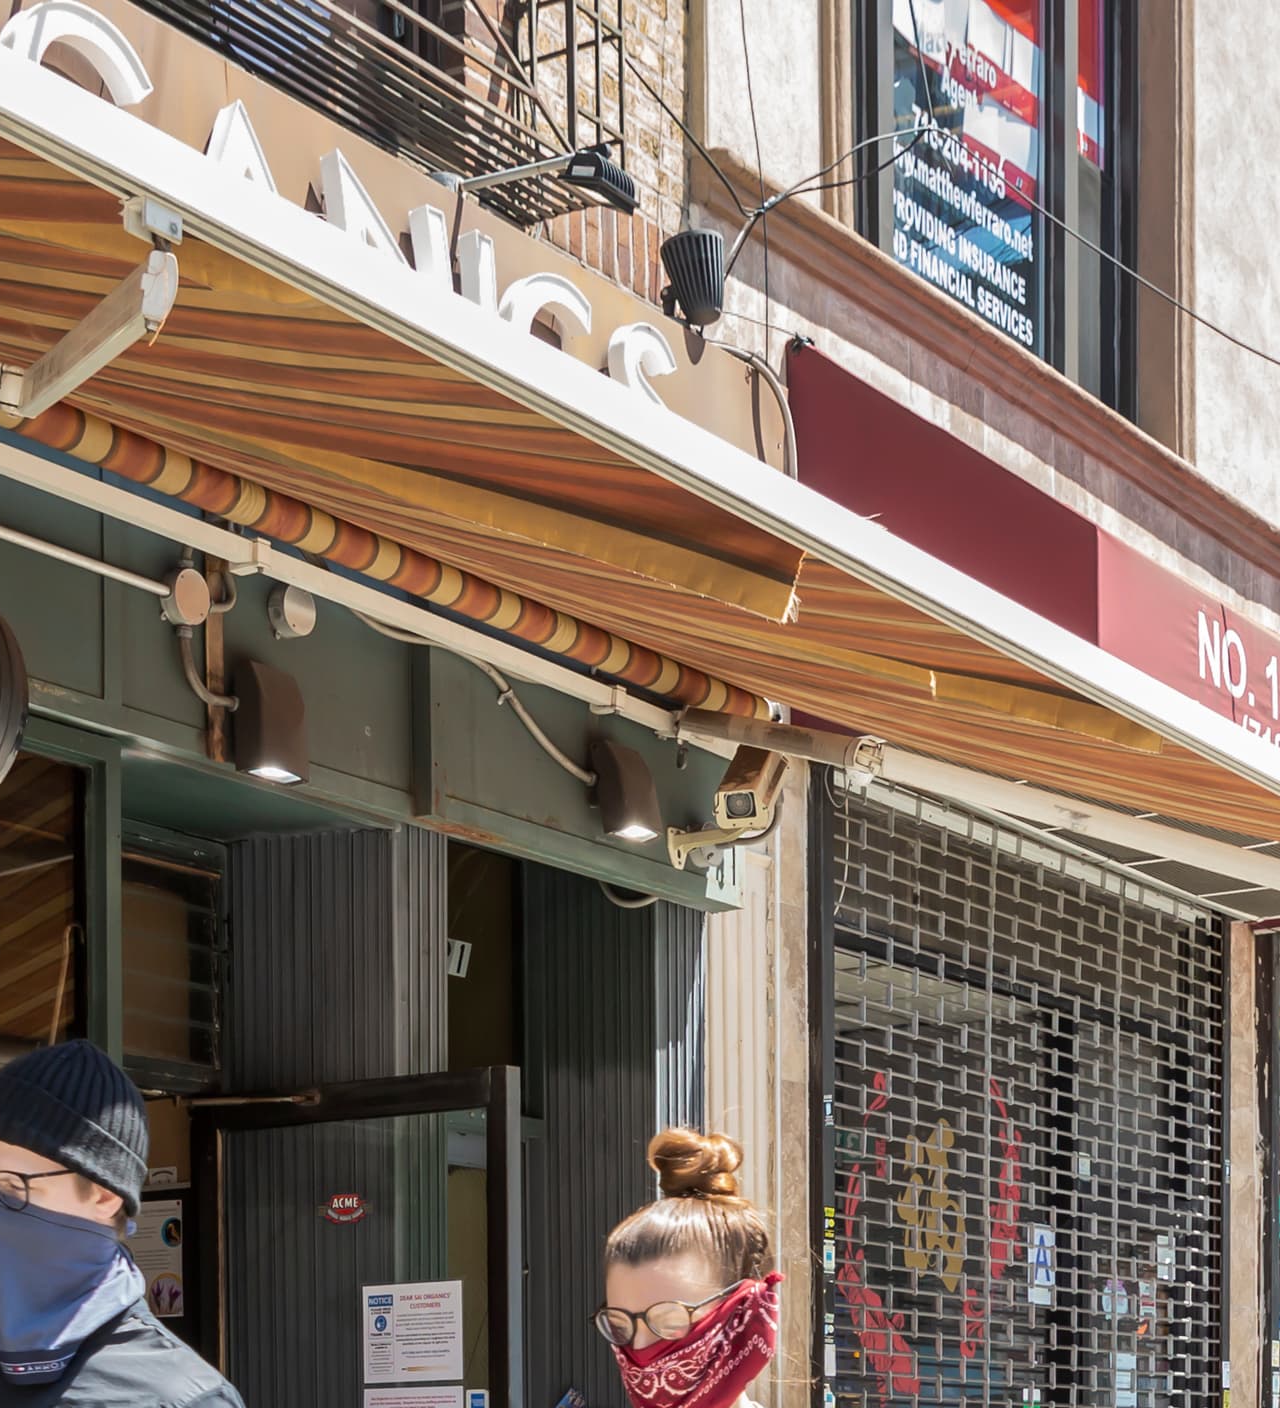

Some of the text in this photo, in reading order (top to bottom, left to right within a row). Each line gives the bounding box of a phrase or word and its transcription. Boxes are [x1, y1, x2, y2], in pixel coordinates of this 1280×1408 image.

[893, 228, 1033, 347] ND FINANCIAL SERVICES
[959, 235, 1026, 305] INSURANCE
[1197, 610, 1256, 707] NO.
[1265, 656, 1279, 720] 1
[332, 1197, 358, 1208] ACME
[368, 1297, 393, 1305] NOTICE
